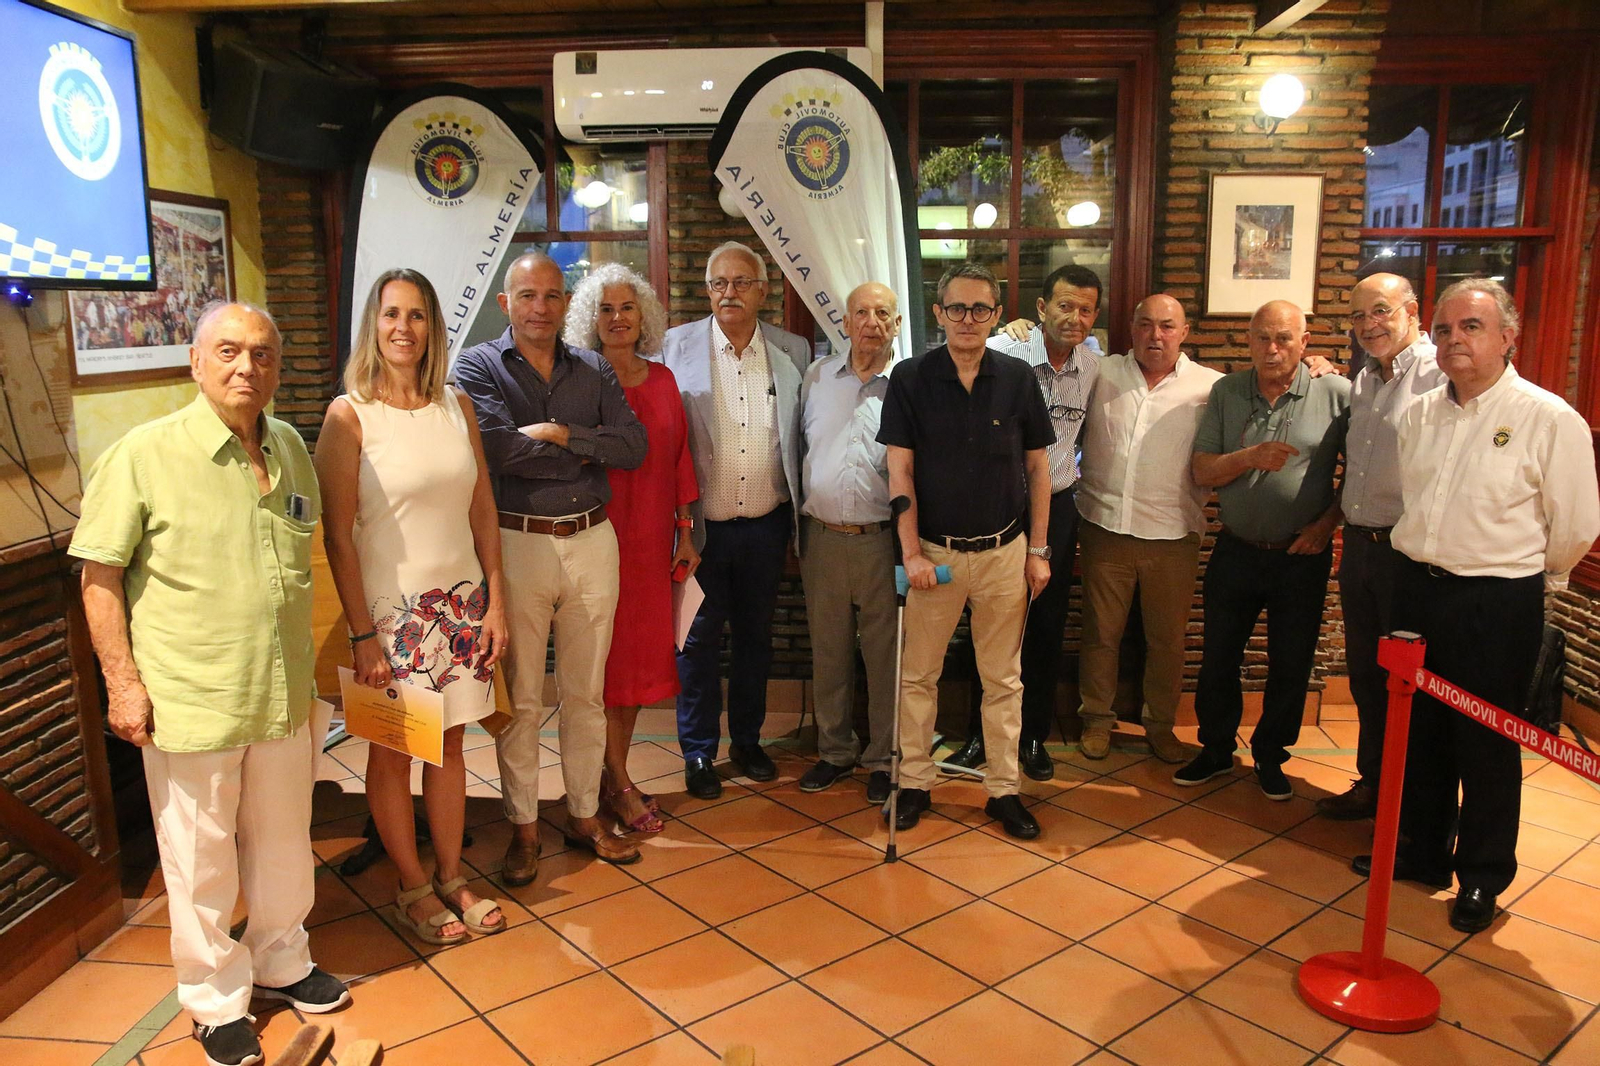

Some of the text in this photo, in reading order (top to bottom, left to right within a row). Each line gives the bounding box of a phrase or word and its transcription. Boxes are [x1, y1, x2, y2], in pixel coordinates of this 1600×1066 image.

[411, 128, 485, 162] AUTOMOVIL CLUB
[426, 196, 464, 207] ALMERIA
[475, 166, 533, 276] ALMERÍA
[1428, 677, 1499, 728] AUTOMOVIL
[1503, 718, 1539, 747] CLUB
